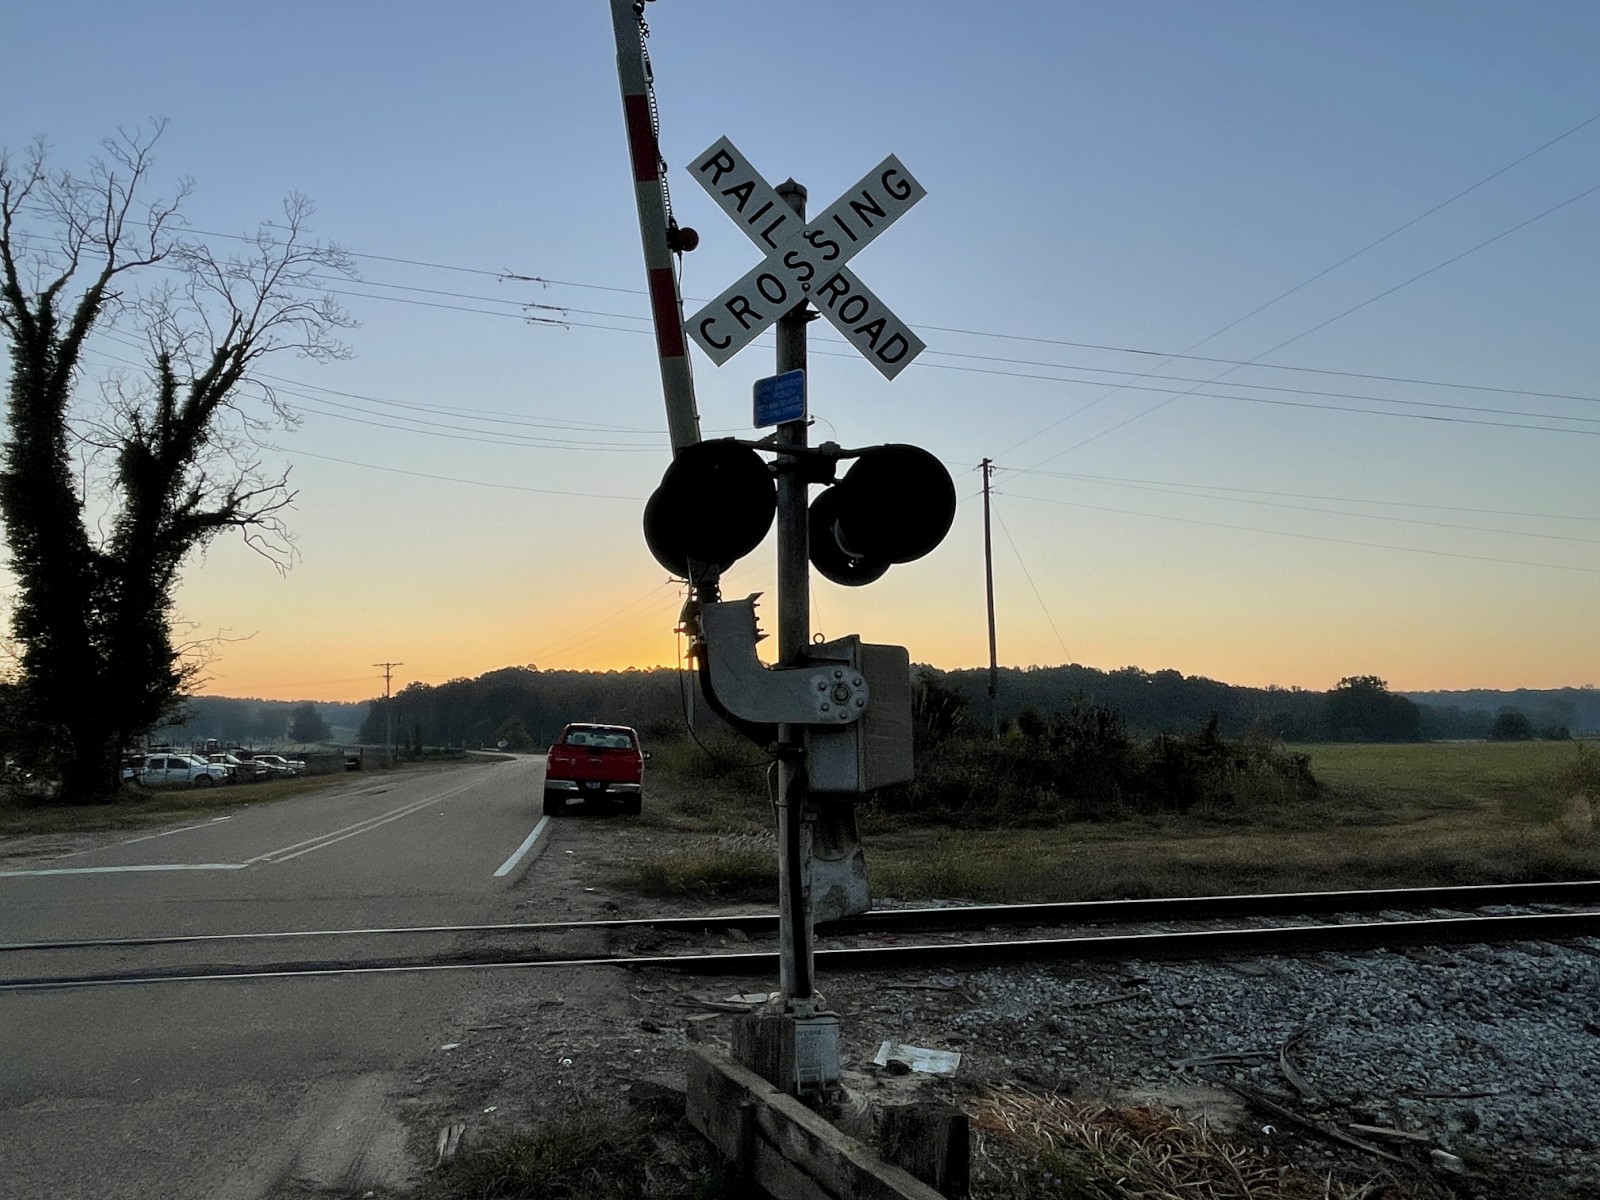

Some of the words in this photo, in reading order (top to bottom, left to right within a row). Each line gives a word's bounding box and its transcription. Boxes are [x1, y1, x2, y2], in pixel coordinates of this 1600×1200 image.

[700, 149, 787, 249] RAIL
[816, 272, 909, 364] ROAD
[700, 169, 912, 350] CROSSING
